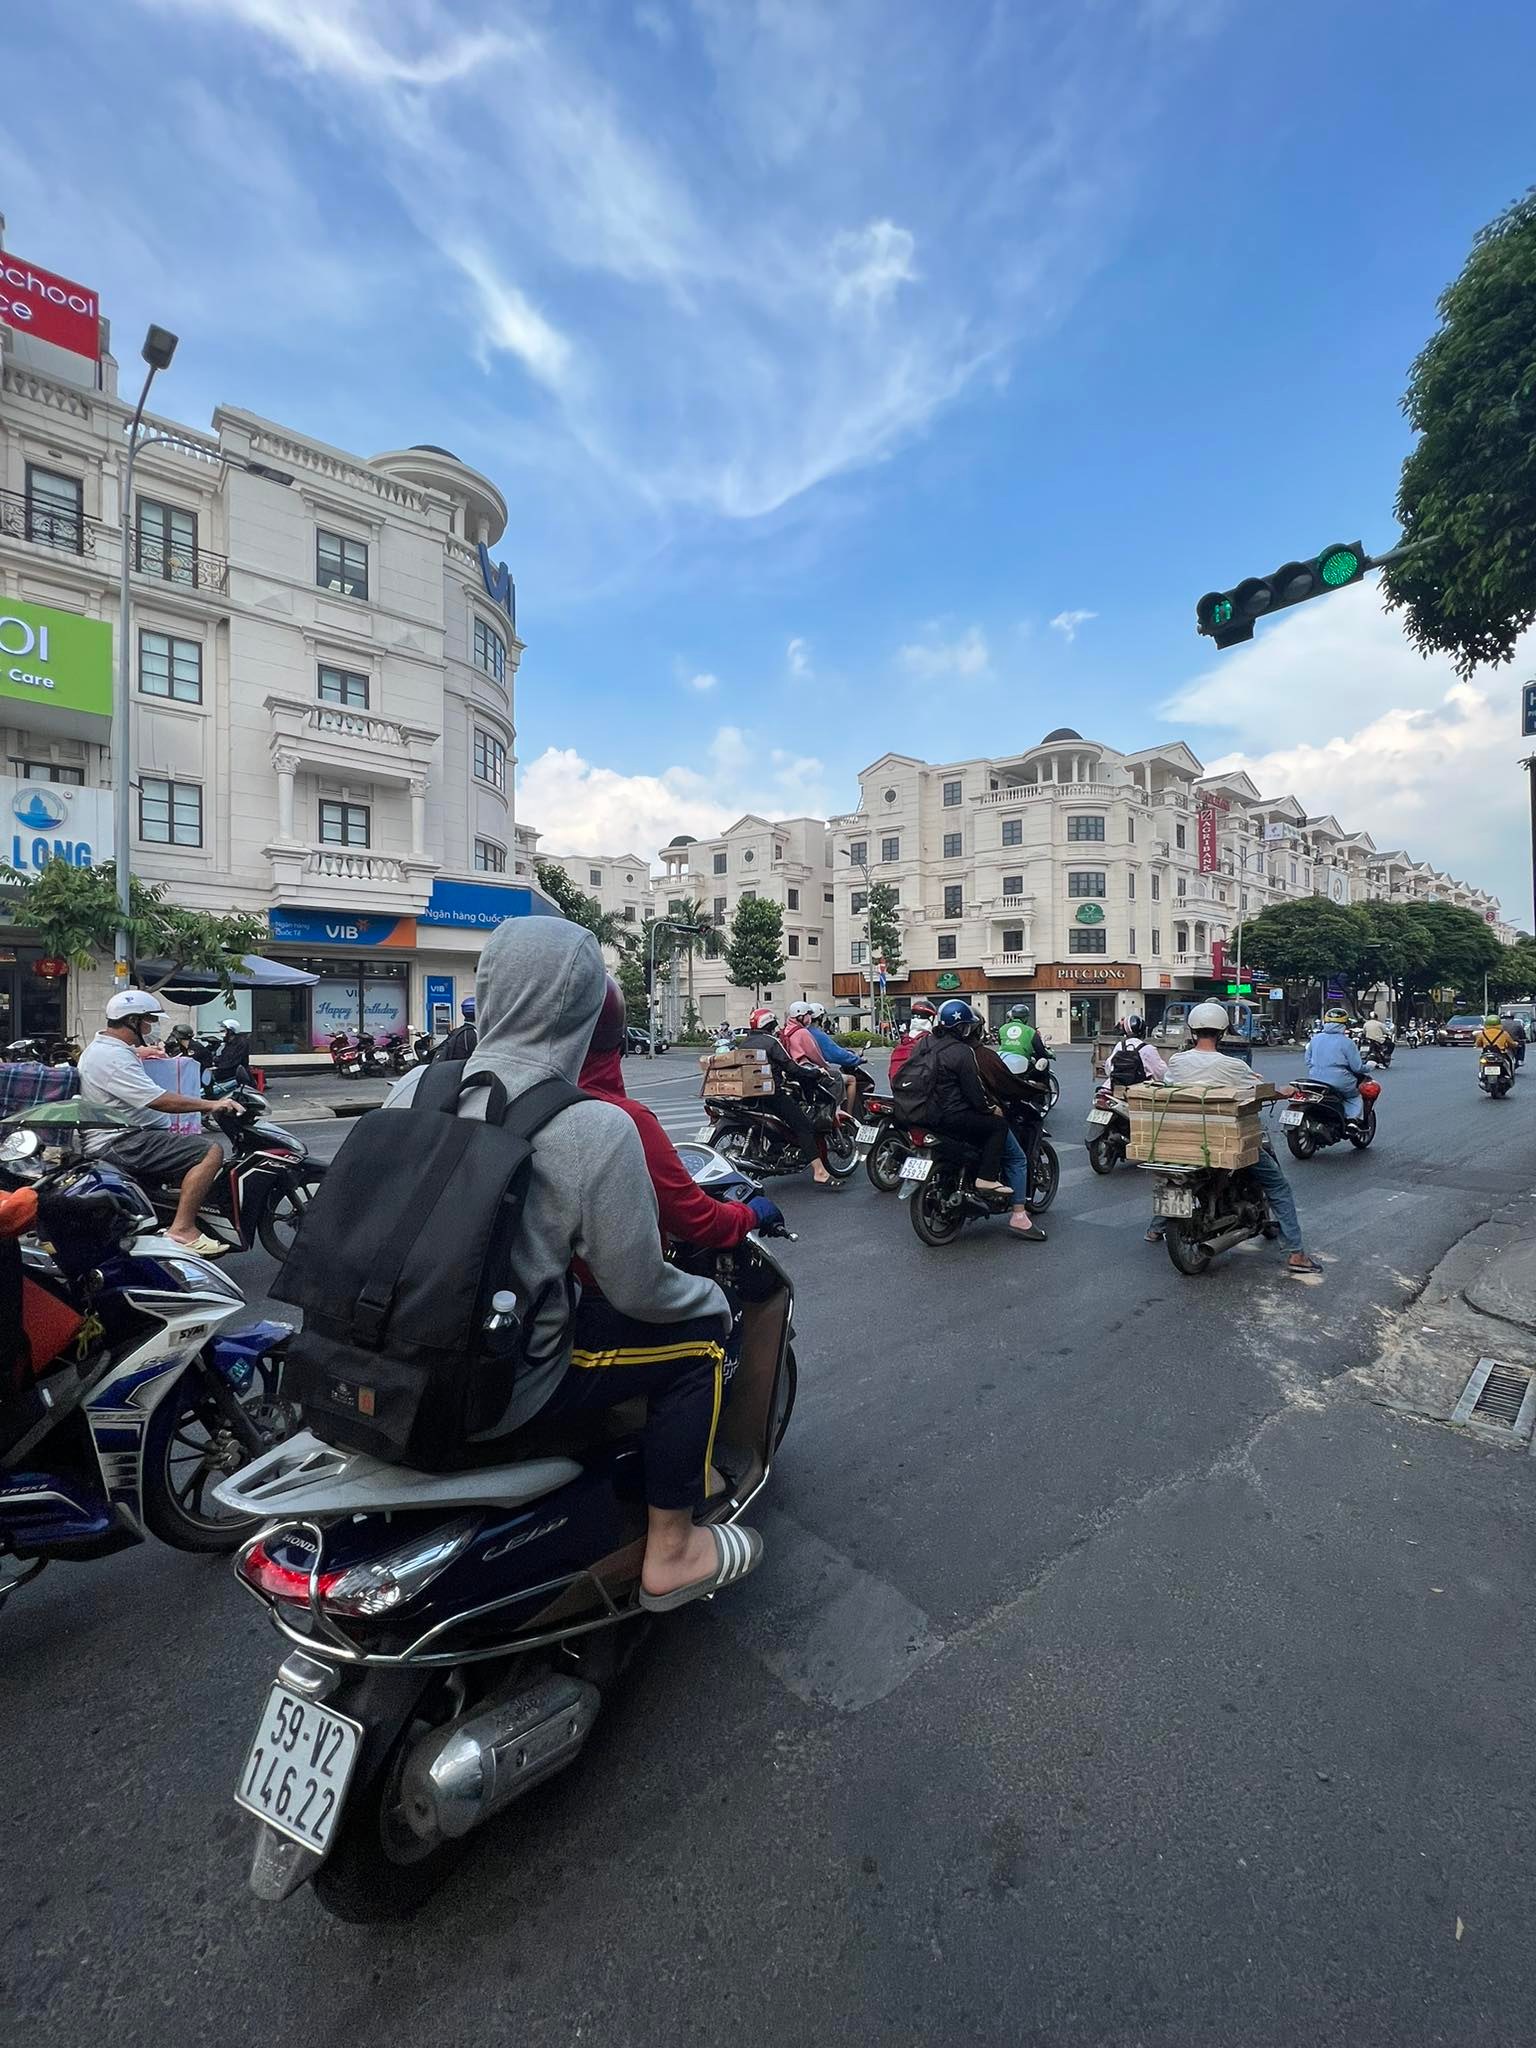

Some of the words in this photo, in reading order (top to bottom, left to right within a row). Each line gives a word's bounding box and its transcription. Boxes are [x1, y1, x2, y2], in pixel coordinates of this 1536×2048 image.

[9, 668, 55, 689] Care
[13, 835, 92, 870] LONG
[1201, 821, 1213, 872] AGRIBANK
[425, 908, 451, 920] Ngân
[452, 910, 477, 923] hàng
[325, 924, 359, 939] VIB
[430, 985, 445, 993] VIB
[316, 1002, 352, 1020] Happy
[179, 1323, 205, 1340] SYM
[271, 1696, 345, 1778] 59-V2
[246, 1747, 336, 1842] 146.22
